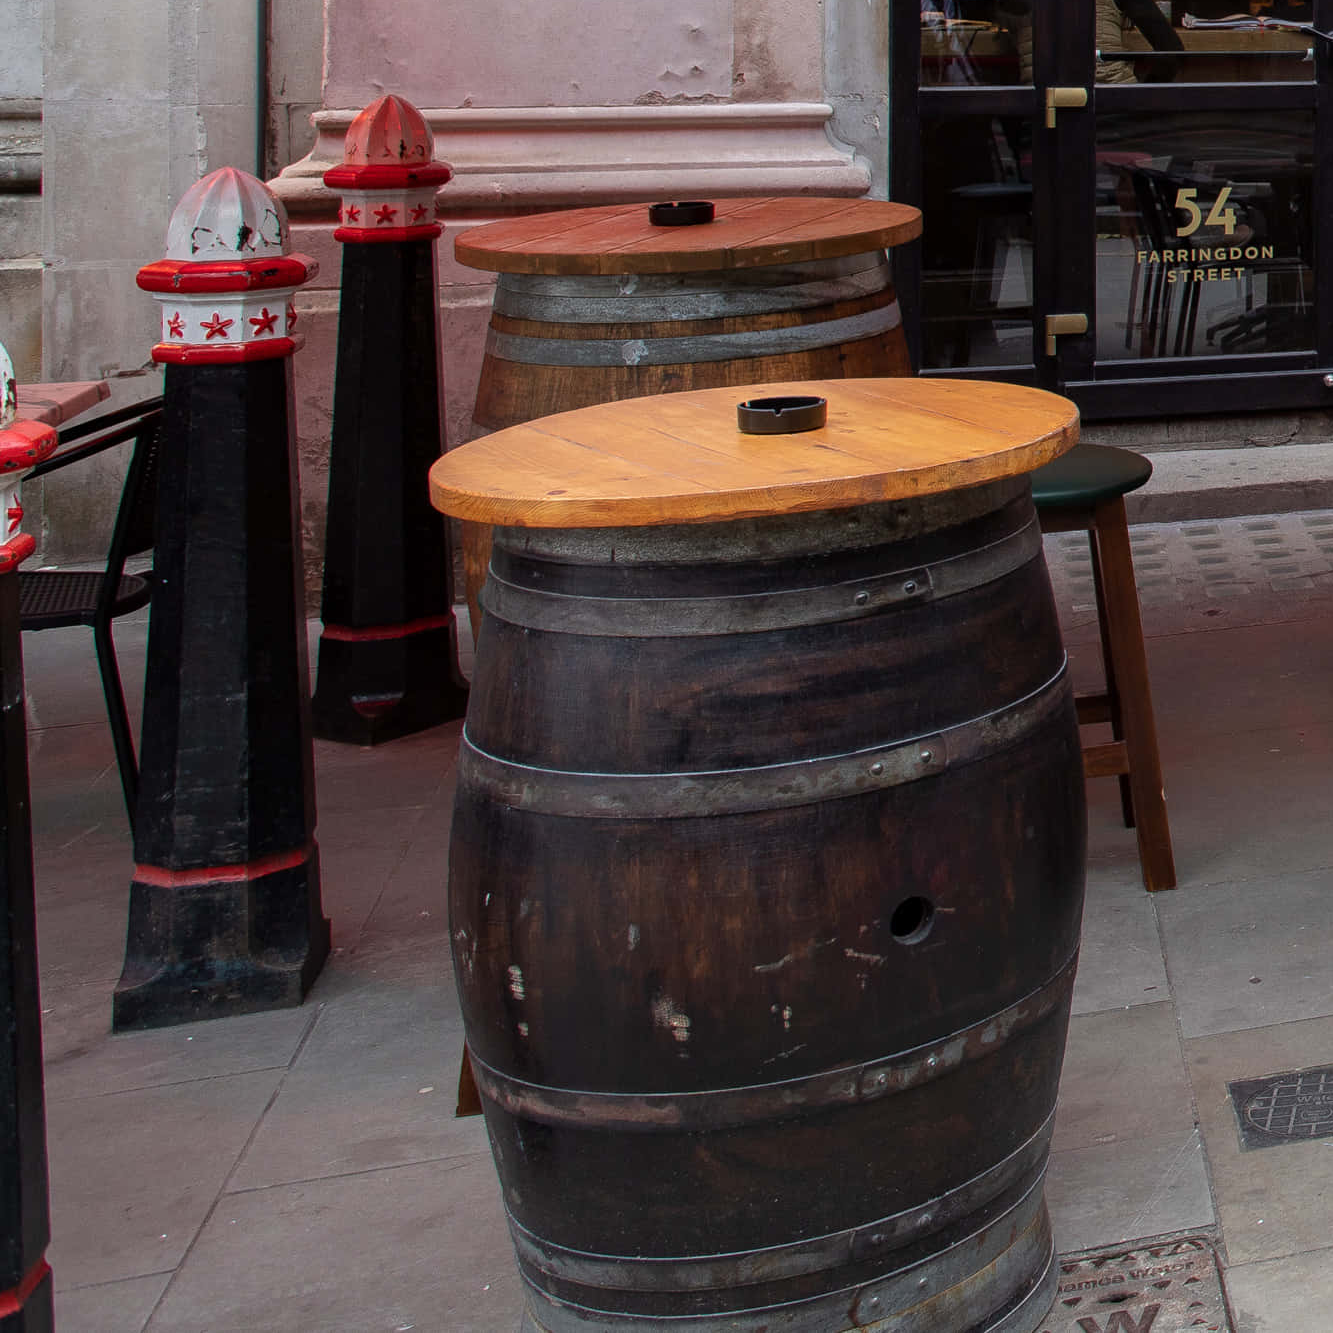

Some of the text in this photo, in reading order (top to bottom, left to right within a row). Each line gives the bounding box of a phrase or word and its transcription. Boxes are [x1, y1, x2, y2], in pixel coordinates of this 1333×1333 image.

[1175, 187, 1237, 237] 54
[1137, 245, 1275, 264] FARRINGDON
[1167, 267, 1246, 283] STREET
